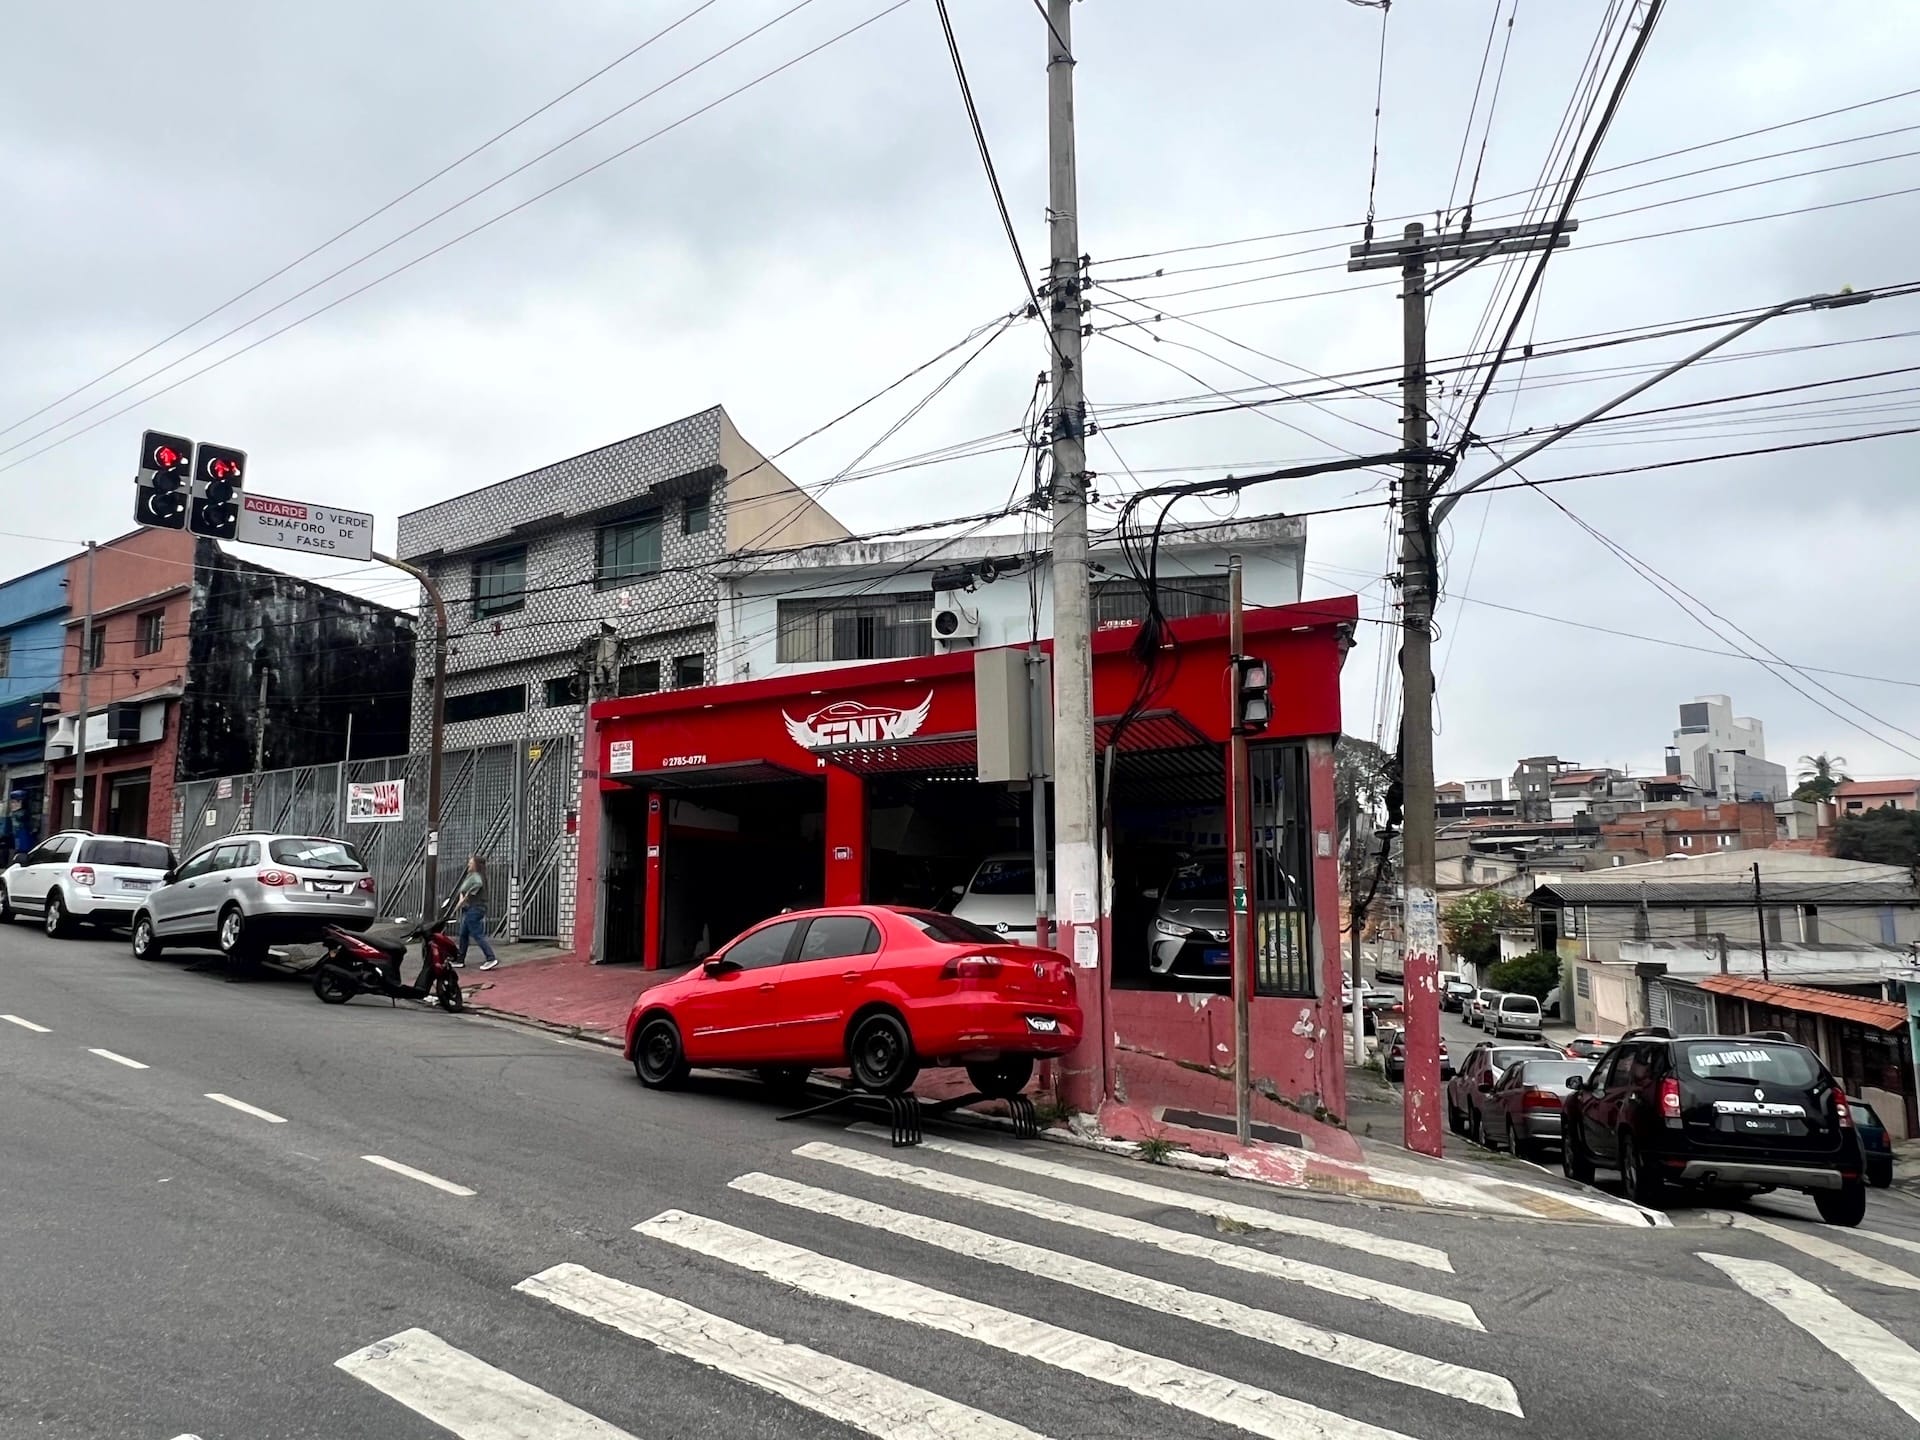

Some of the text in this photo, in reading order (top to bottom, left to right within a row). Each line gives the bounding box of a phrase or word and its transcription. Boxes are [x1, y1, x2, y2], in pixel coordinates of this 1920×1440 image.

[246, 500, 369, 528] AGUARDE O VERDE
[258, 515, 355, 539] SEMÁFORO DE
[276, 532, 336, 550] 3 FASES
[814, 715, 902, 747] FENIX
[668, 754, 707, 767] 2785-0774
[1696, 1050, 1772, 1067] SEM ENTRADA
